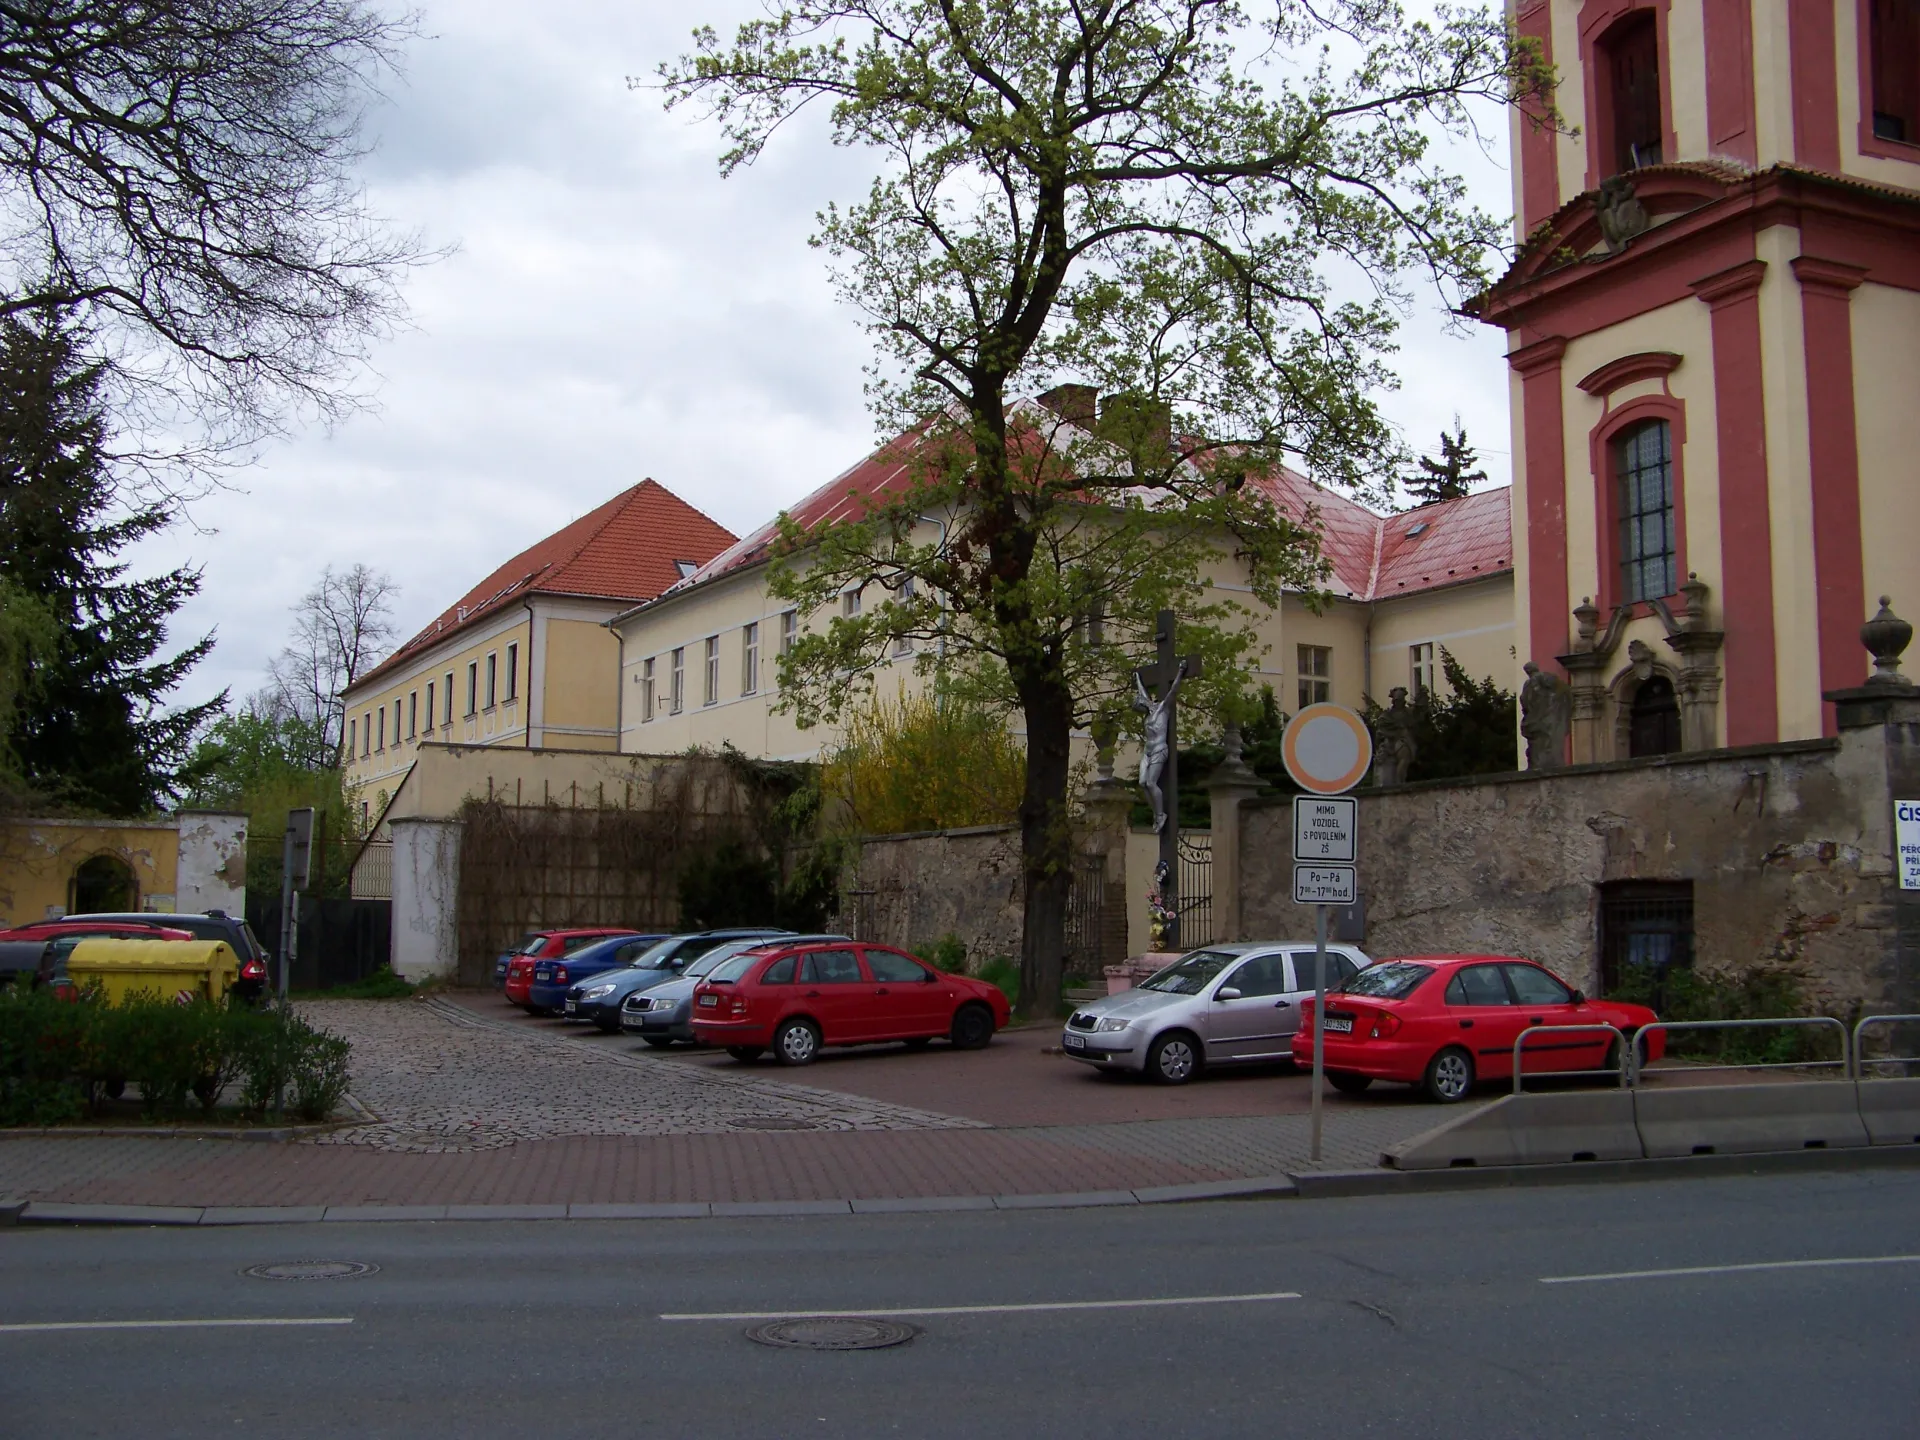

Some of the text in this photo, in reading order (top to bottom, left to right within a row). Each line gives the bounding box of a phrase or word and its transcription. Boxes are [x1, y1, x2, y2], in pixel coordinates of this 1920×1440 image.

[1316, 805, 1335, 815] MIMO
[1312, 818, 1340, 828] VOZIDEL
[1303, 830, 1347, 841] S POVOLENÍM
[1321, 842, 1329, 854] ZŠ
[1332, 887, 1351, 898] hod.
